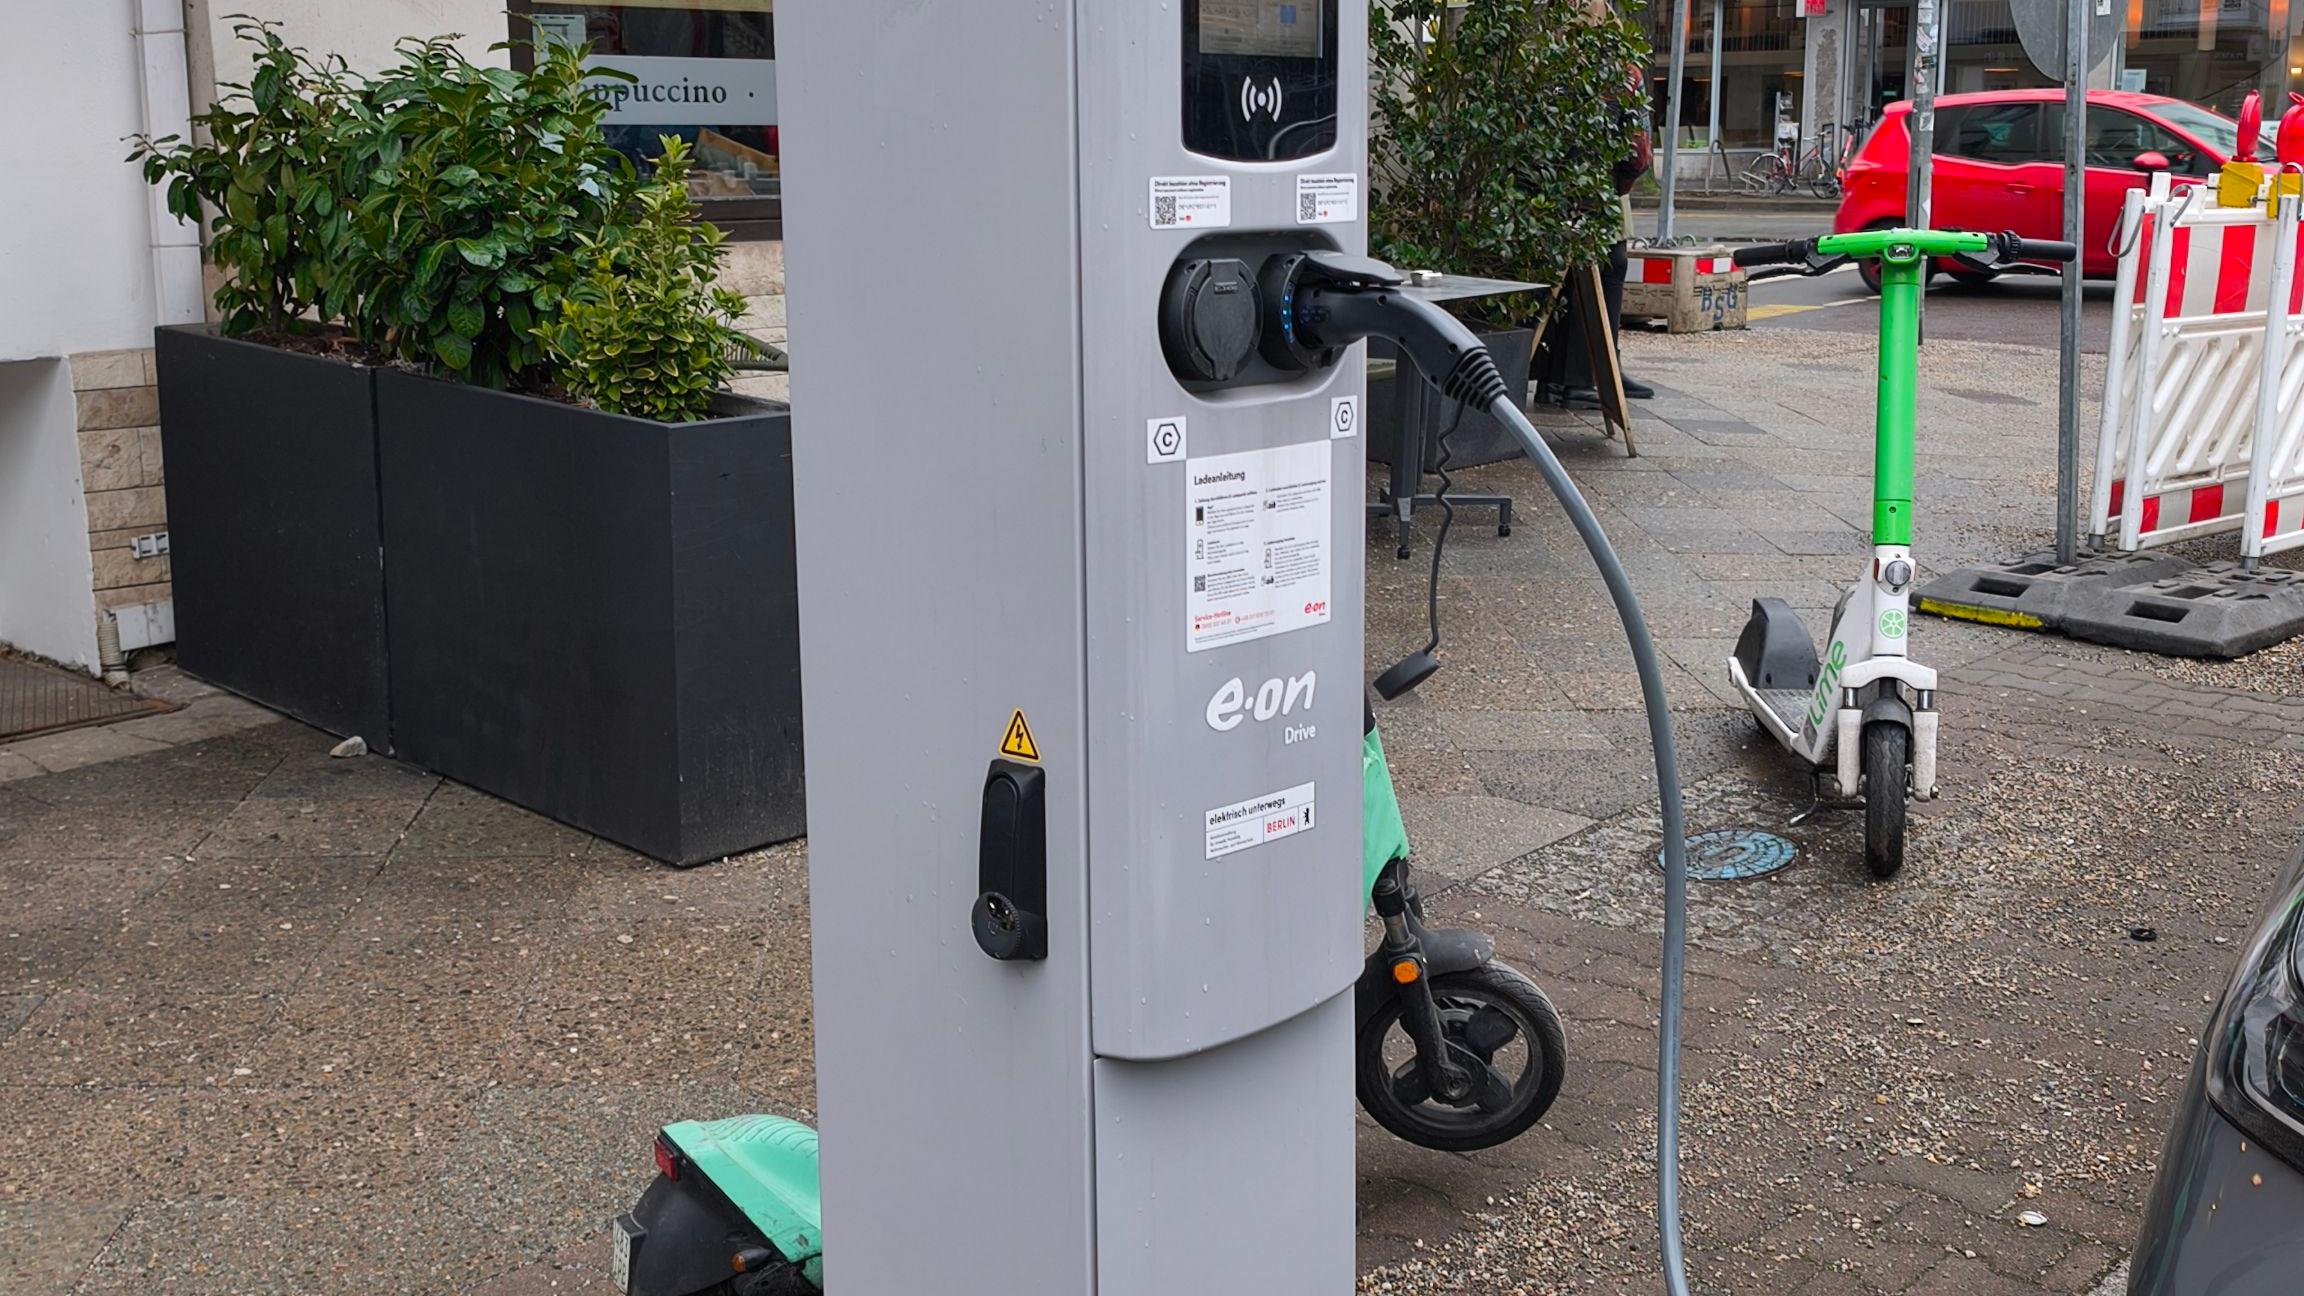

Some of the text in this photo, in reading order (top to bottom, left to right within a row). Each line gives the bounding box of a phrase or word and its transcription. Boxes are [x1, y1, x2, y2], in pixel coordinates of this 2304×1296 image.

[1341, 410, 1348, 425] C
[1162, 432, 1173, 448] C
[1194, 471, 1246, 486] Ladeanleitung
[1809, 641, 1847, 725] Lime
[1284, 723, 1316, 745] Drive
[1209, 797, 1286, 825] elektrisch unterwegs
[1266, 816, 1296, 833] BERLIN
